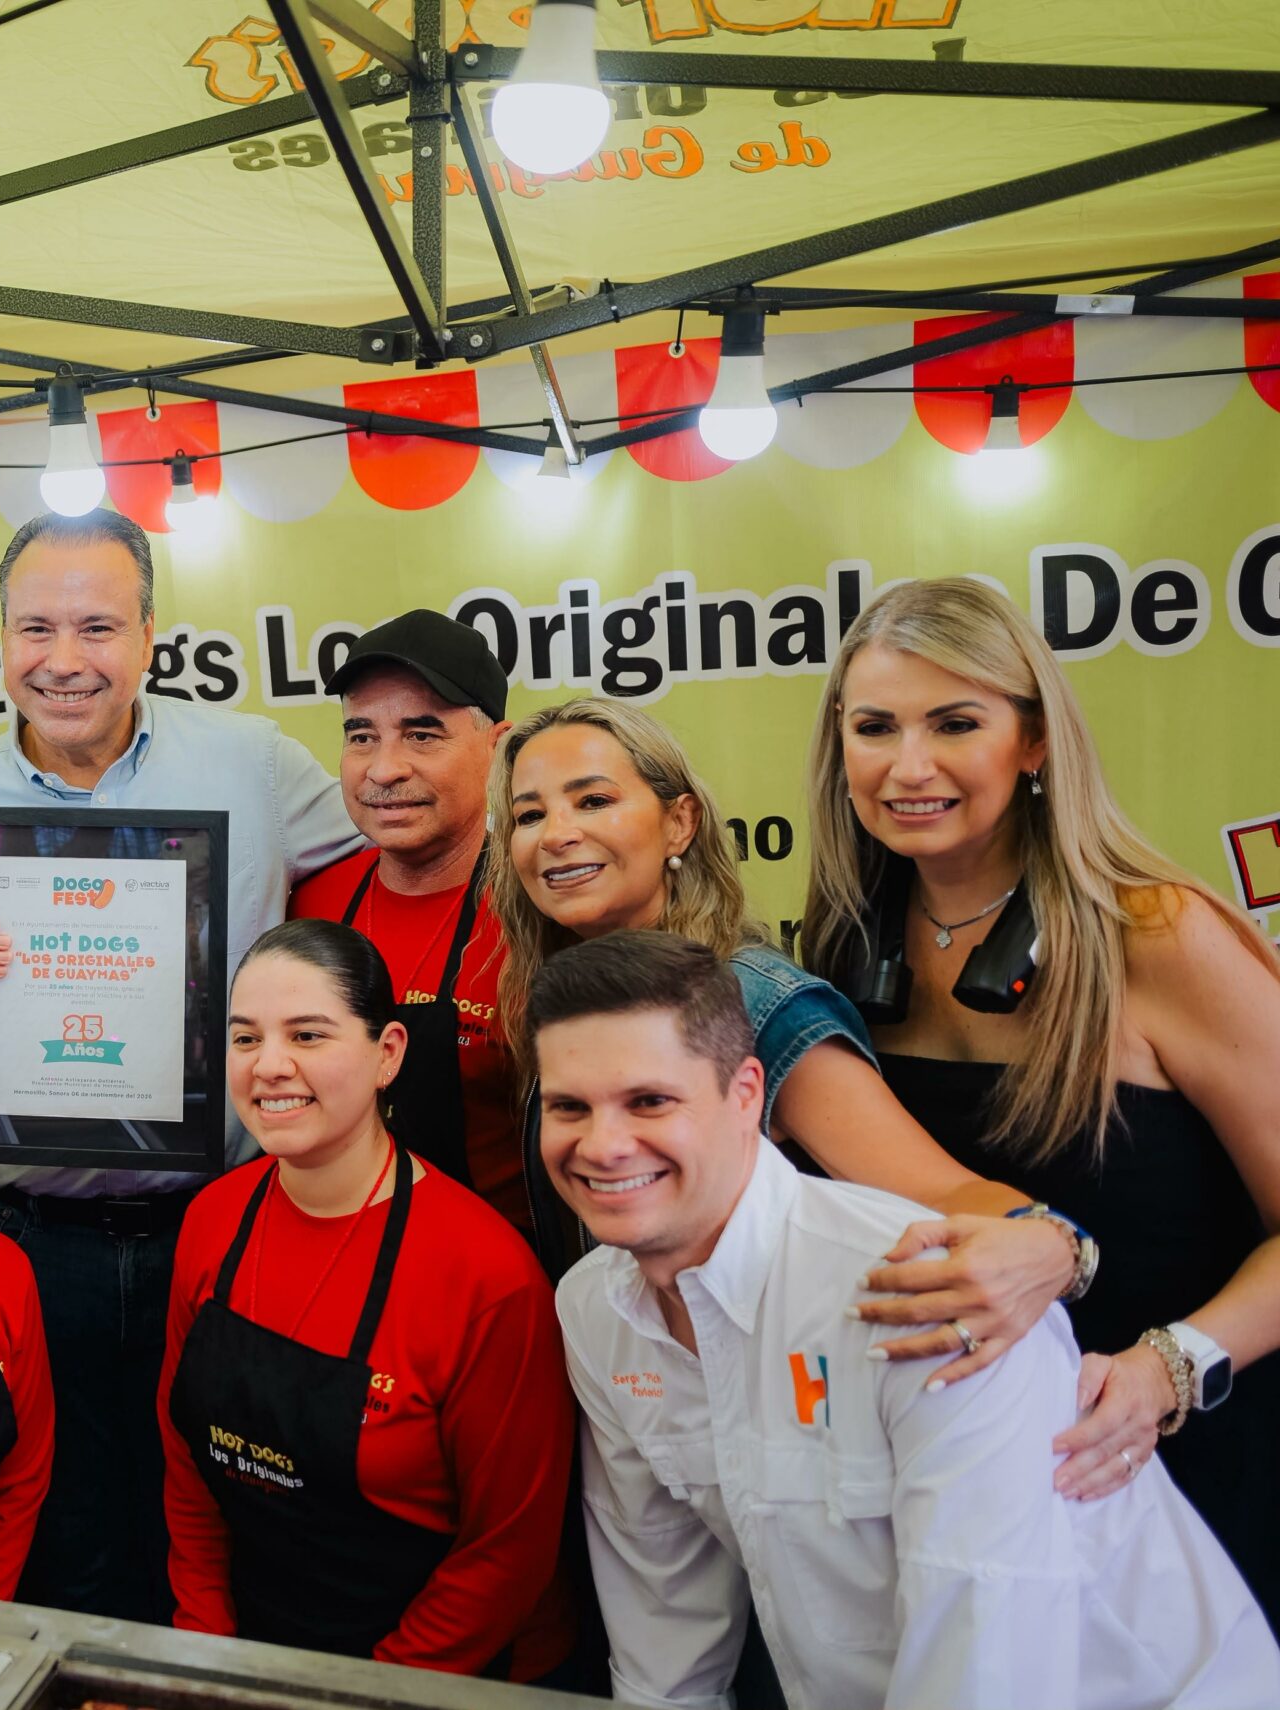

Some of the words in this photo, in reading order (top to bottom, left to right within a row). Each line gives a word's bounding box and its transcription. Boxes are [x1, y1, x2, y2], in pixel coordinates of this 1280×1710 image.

[266, 615, 360, 698] Lo
[455, 570, 861, 698] Original
[1042, 554, 1199, 651] De
[53, 876, 105, 892] DOGO
[78, 934, 140, 953] DOGS
[57, 954, 155, 968] ORIGINALES
[32, 967, 50, 979] DE
[63, 1014, 104, 1042] 25
[62, 1042, 105, 1058] Años
[210, 1425, 245, 1454] HOT
[210, 1443, 229, 1465] Los
